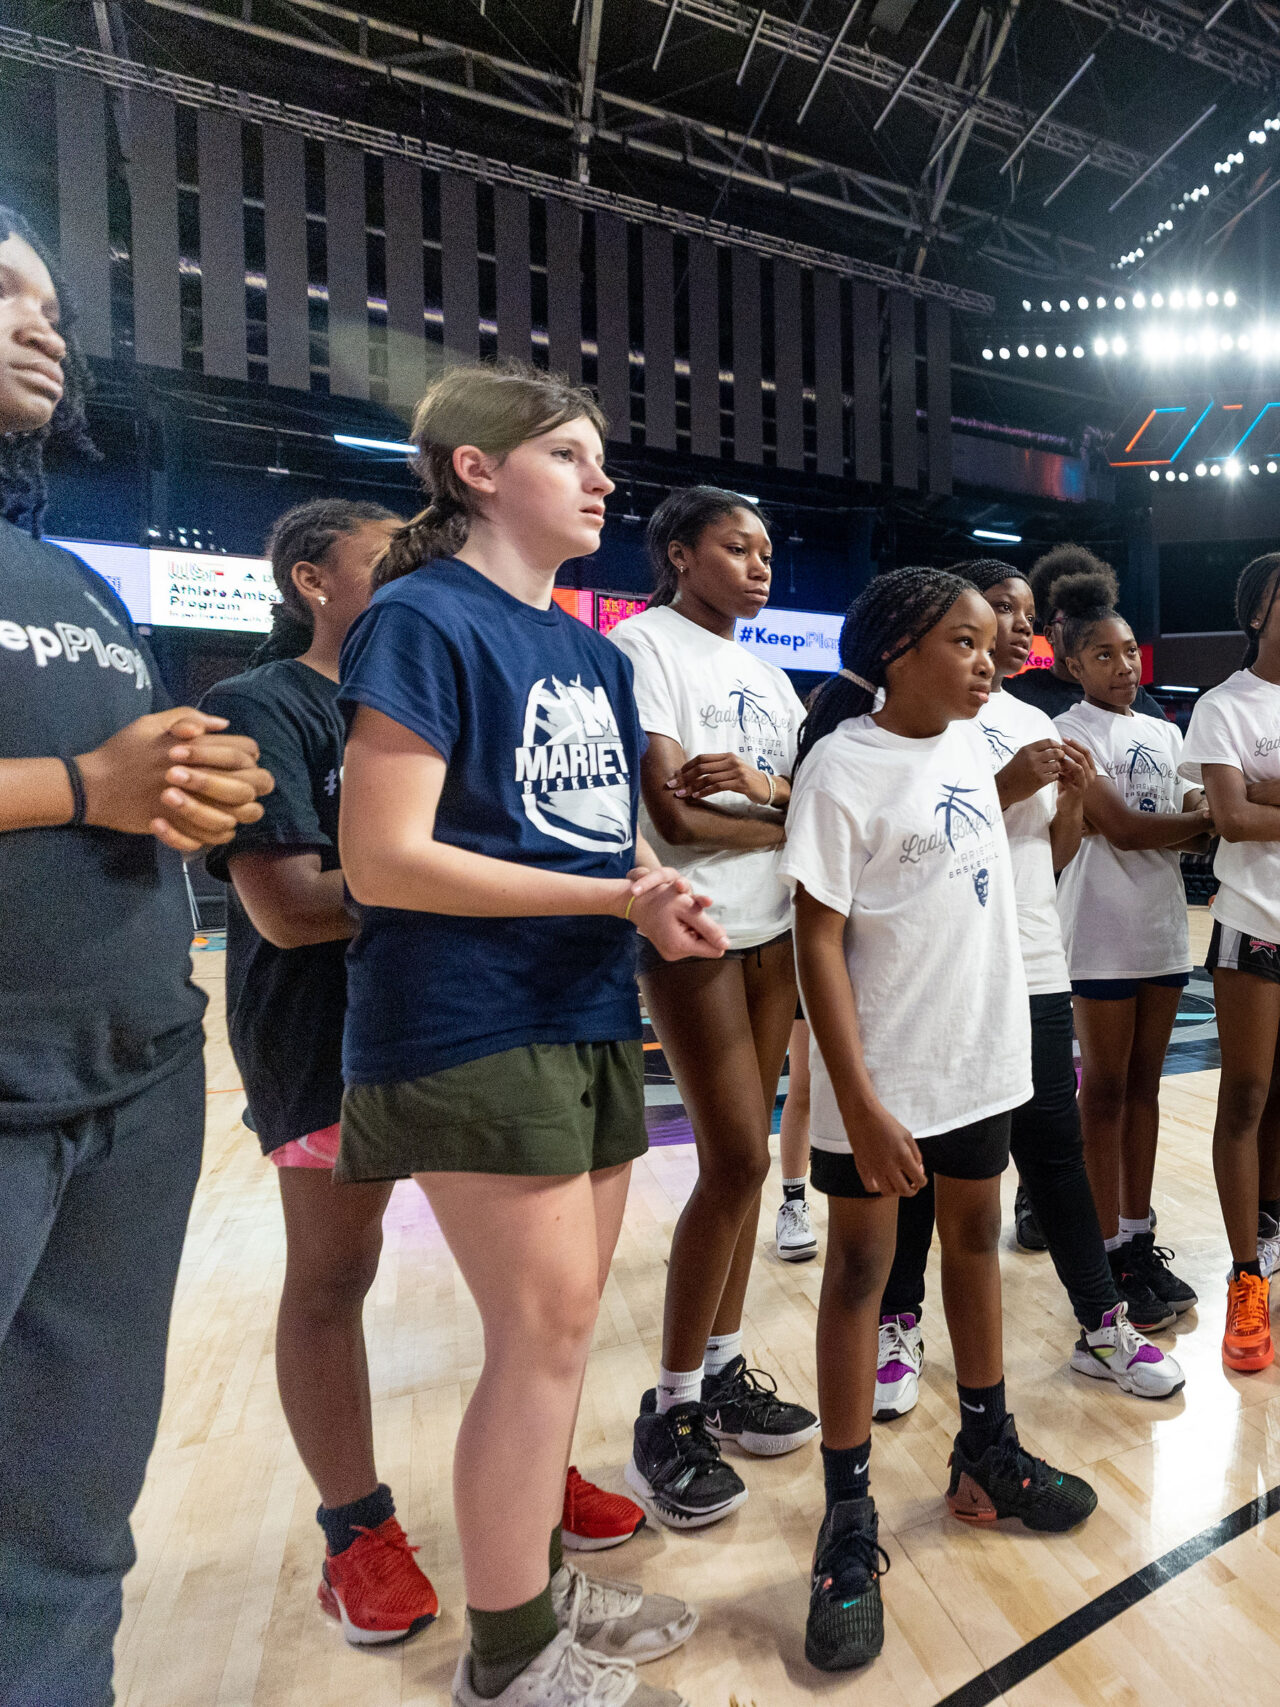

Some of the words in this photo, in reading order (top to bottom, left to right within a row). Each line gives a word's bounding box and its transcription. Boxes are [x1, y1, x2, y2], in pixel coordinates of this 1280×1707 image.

[170, 583, 227, 598] Athlete
[170, 595, 241, 611] Program
[566, 686, 620, 737] M
[899, 826, 948, 864] Lady
